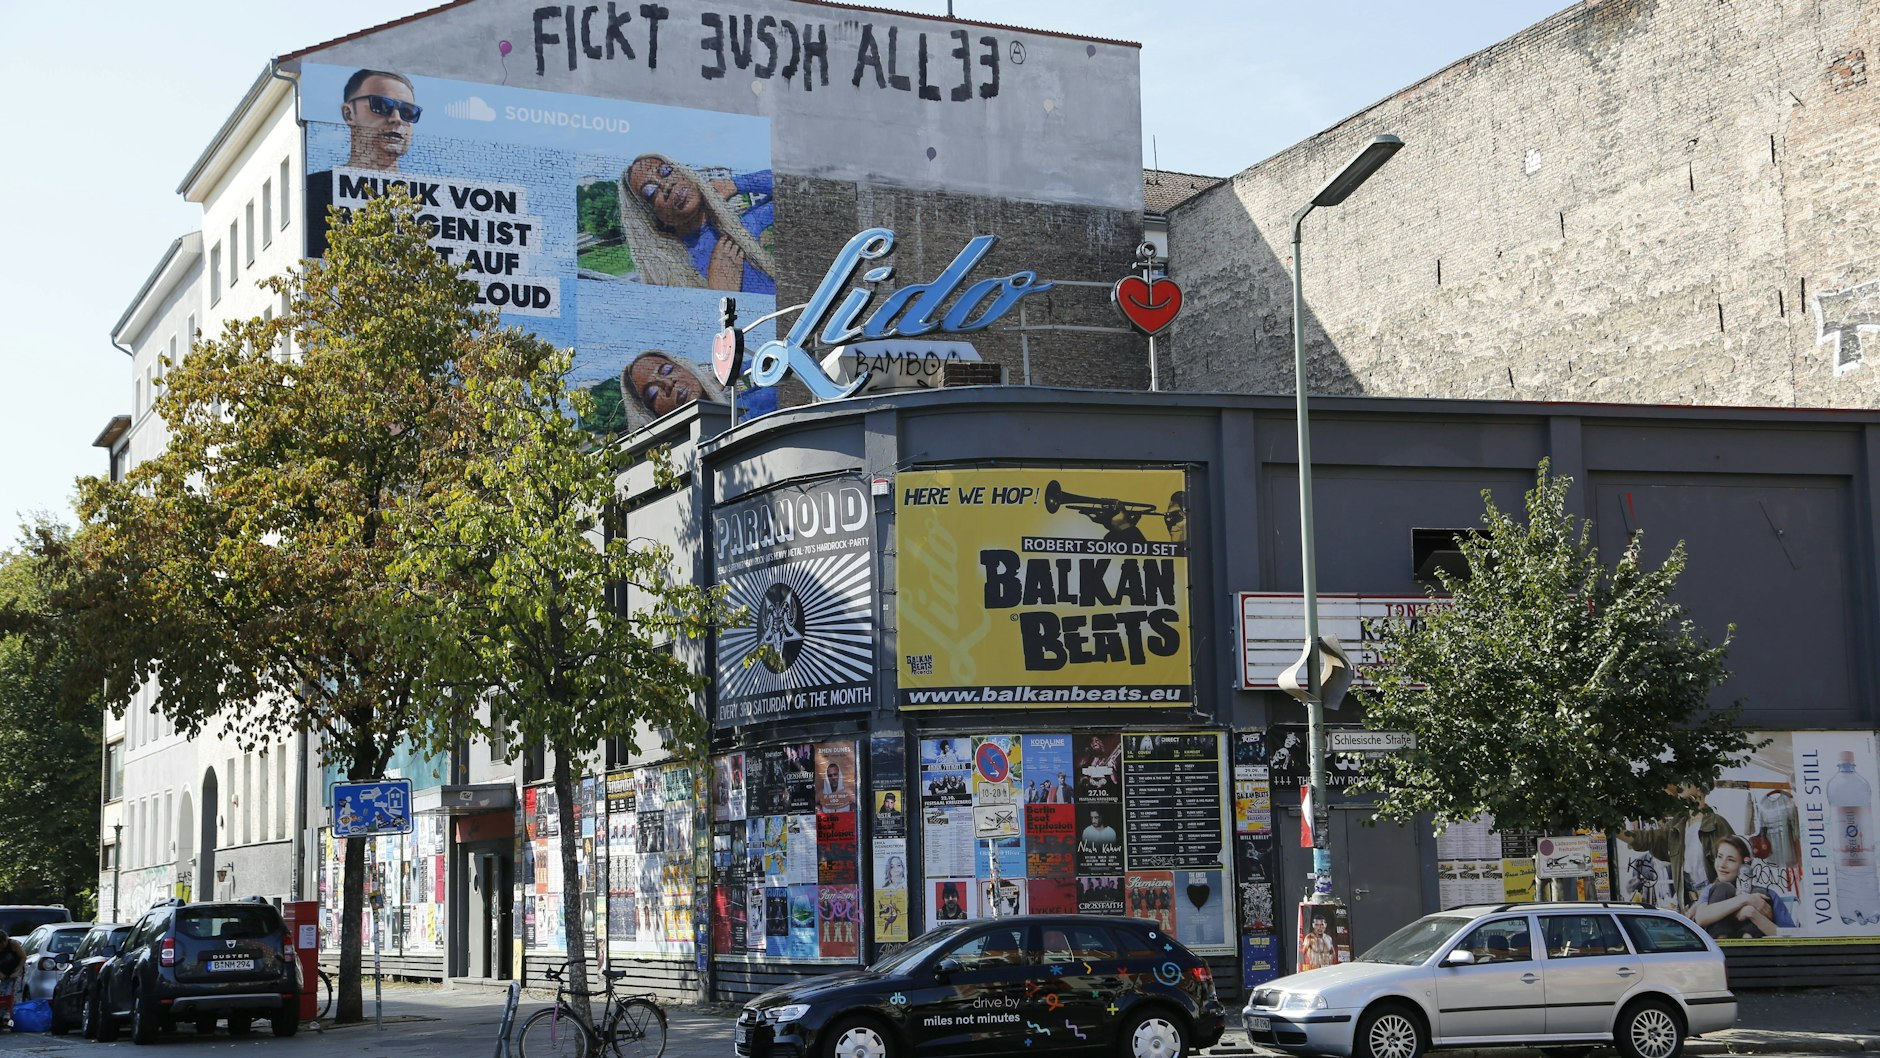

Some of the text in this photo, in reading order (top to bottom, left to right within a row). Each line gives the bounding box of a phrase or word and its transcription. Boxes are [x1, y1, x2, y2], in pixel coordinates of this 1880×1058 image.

[533, 2, 669, 77] FICKT
[852, 23, 1000, 101] ALLEE
[505, 105, 631, 133] SOUNDCLOUD
[339, 174, 516, 214] MUSIK VON
[487, 221, 531, 247] IST
[464, 249, 519, 276] AUF
[751, 227, 1054, 400] Lido
[904, 487, 1040, 506] HERE WE HOP!
[716, 487, 869, 560] PARANOID
[1024, 538, 1178, 556] ROBERT SOKO DJ SET
[980, 549, 1176, 609] BALKAN
[1019, 609, 1181, 671] BEATS
[719, 686, 872, 721] EVERY 3RD SATURDAY OF THE MONTH
[909, 686, 1181, 704] www.balkanbeats.eu
[1030, 738, 1065, 750] KODALINE
[1334, 734, 1412, 746] Schlesische Straße
[1325, 776, 1344, 786] EAVY
[1026, 806, 1055, 814] Berlin
[817, 831, 854, 841] Explosion
[1027, 822, 1073, 833] Explosion
[1802, 749, 1832, 925] VOLLE PULLE STILL
[1126, 876, 1173, 889] Samiam
[1031, 906, 1062, 914] LYKKE
[1078, 901, 1124, 910] CROSSFAITH
[972, 995, 1021, 1010] drive by
[923, 1012, 1021, 1027] miles not minutes
